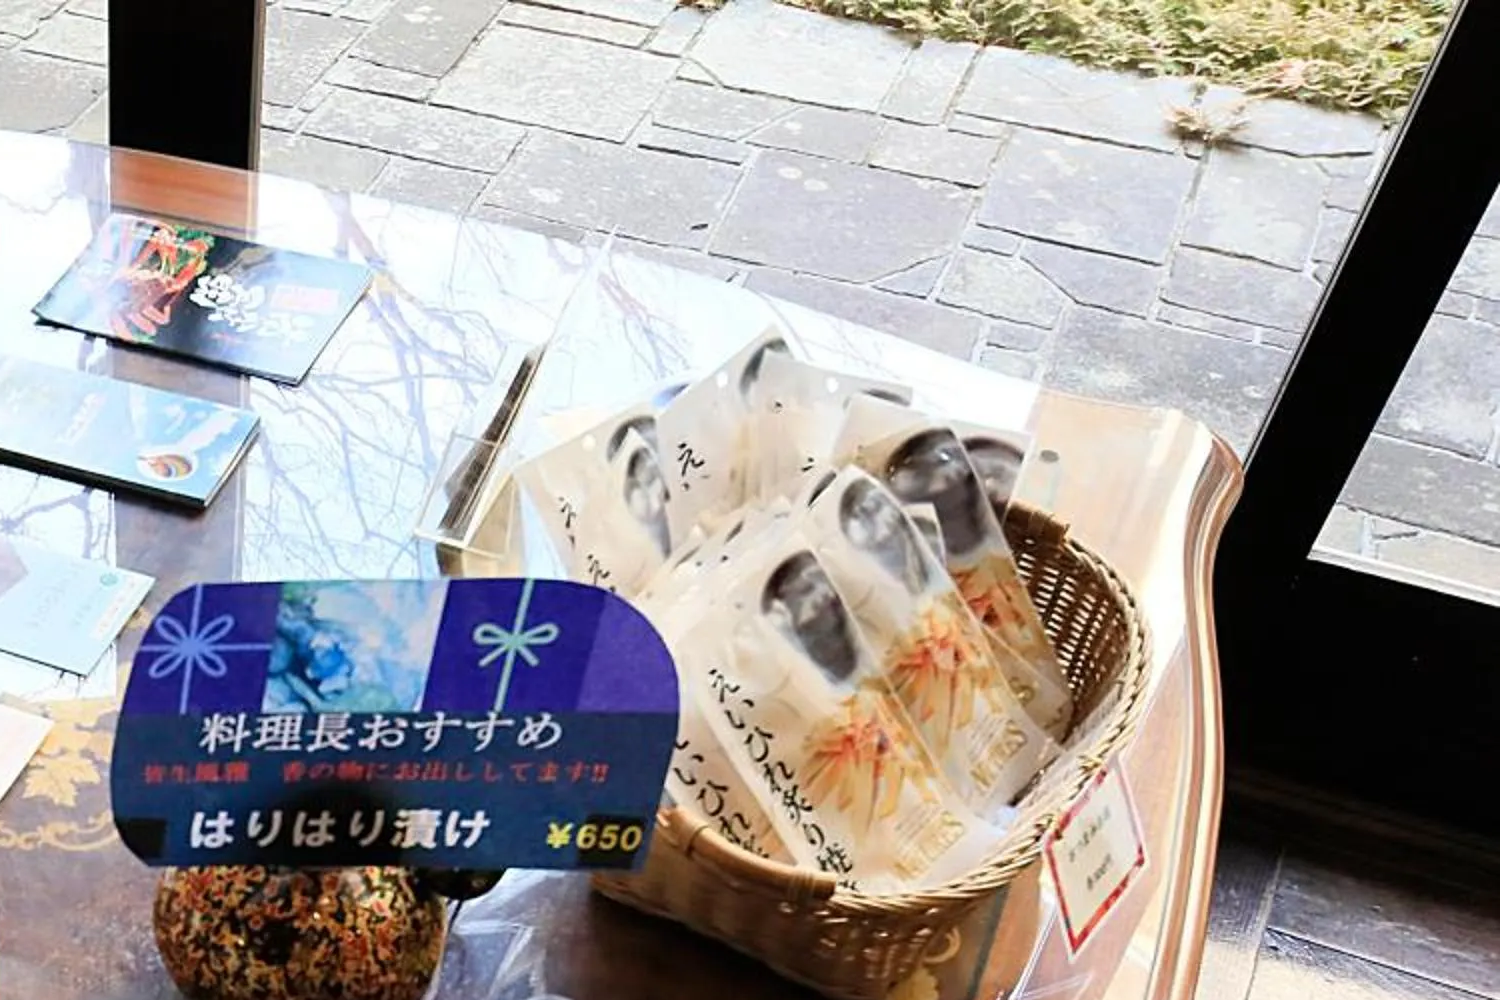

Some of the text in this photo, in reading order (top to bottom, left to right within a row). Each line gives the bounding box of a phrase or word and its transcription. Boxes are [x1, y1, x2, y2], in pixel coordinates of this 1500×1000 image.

[197, 711, 564, 753] 料理長おすすめ
[190, 809, 491, 850] はりはり漬け
[545, 822, 644, 852] ¥650
